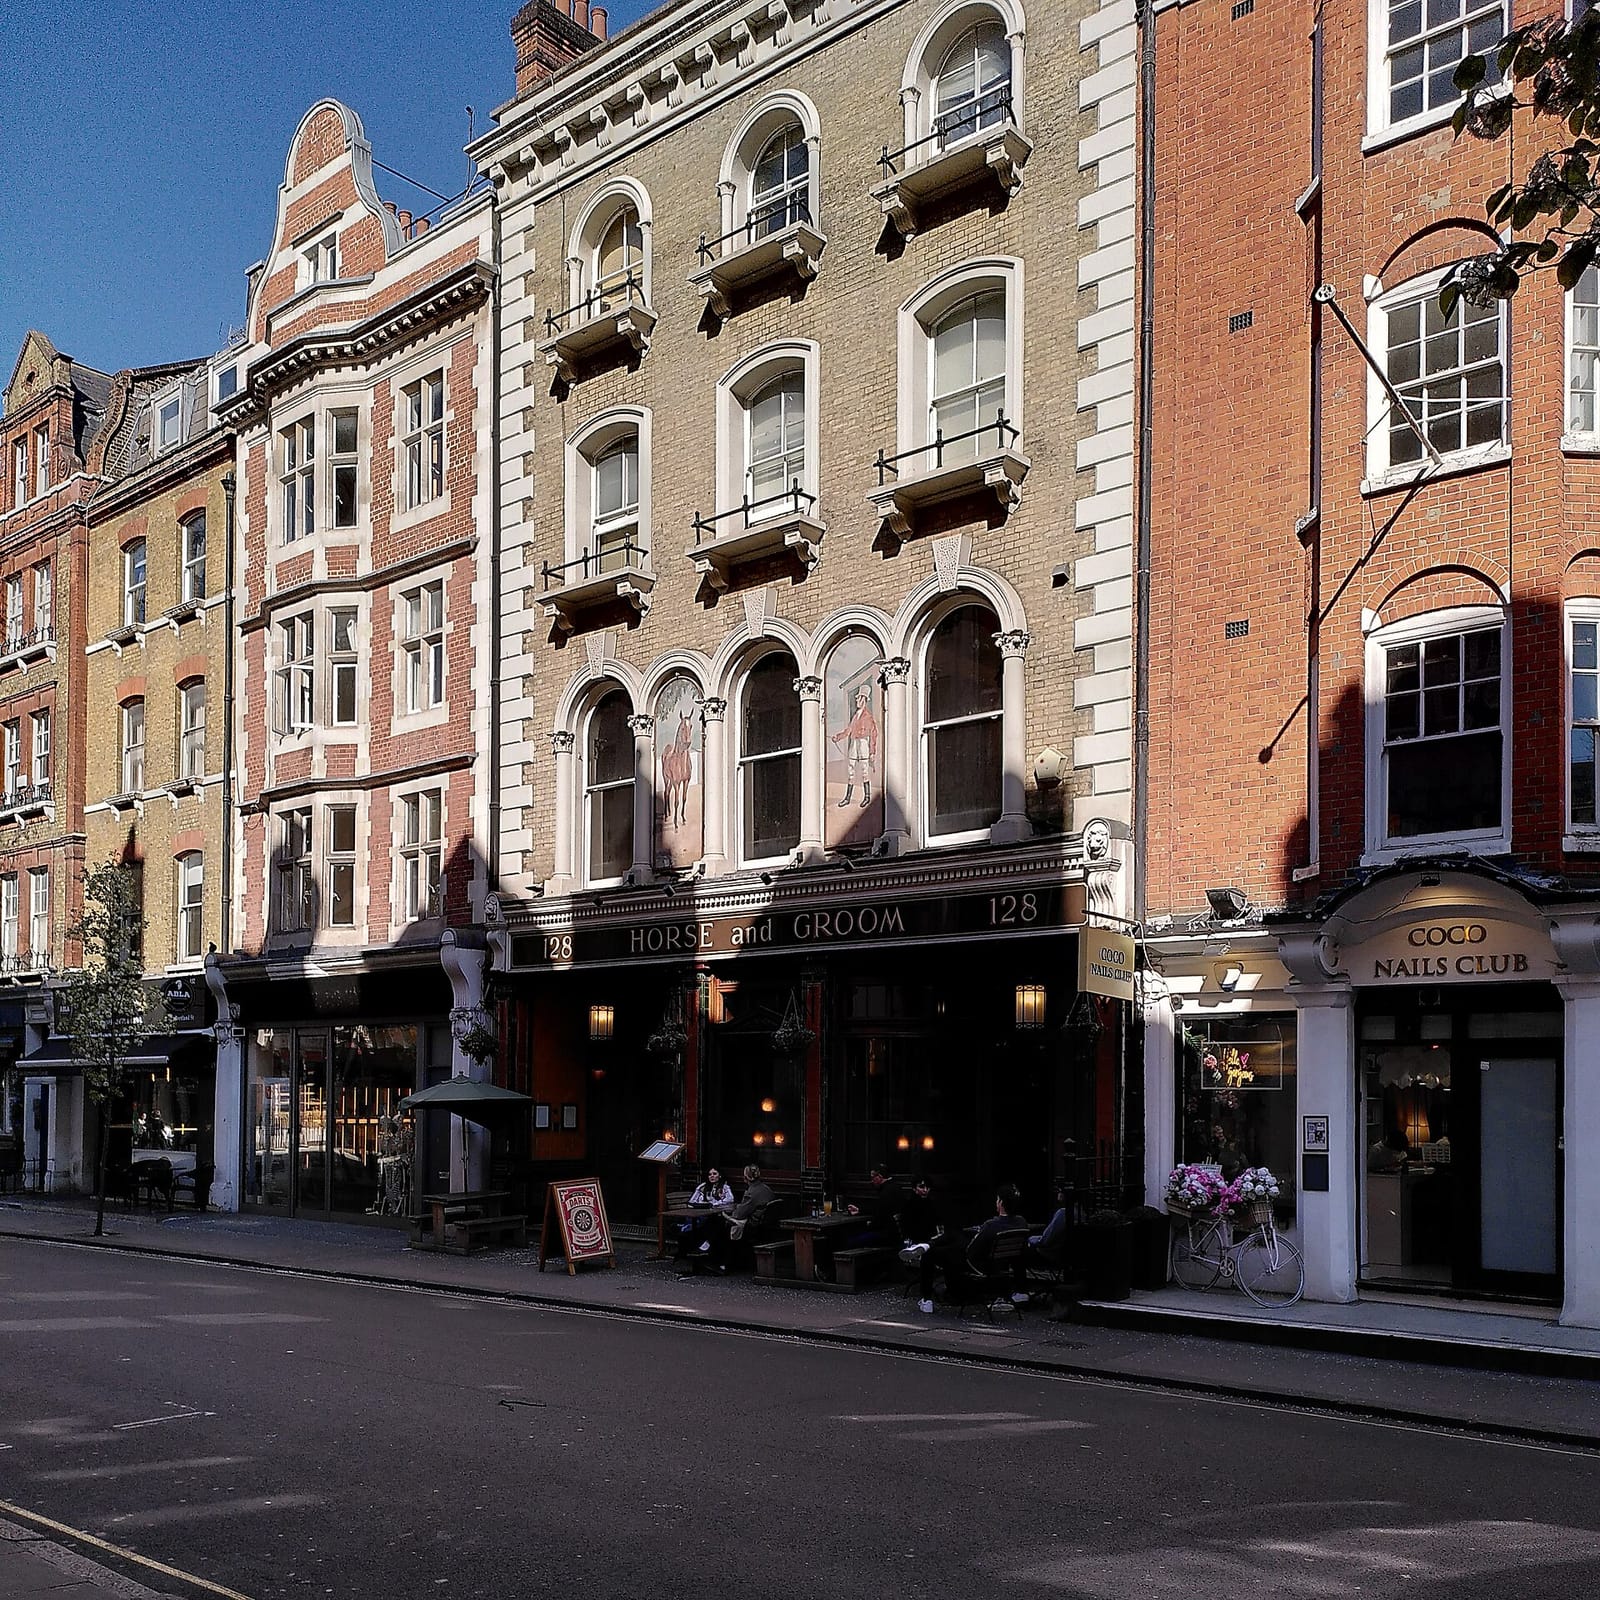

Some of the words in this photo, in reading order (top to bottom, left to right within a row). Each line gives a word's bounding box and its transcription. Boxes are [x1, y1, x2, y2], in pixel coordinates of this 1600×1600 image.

[543, 935, 573, 959] 128
[630, 922, 714, 952] HORSE
[731, 918, 772, 947] and
[793, 905, 906, 940] GROOM
[988, 893, 1038, 925] 128
[1408, 924, 1487, 947] COCO
[1100, 947, 1125, 965] COCO
[1374, 956, 1448, 978] NAILS
[1455, 953, 1529, 975] CLUB
[1090, 963, 1113, 979] NAILS
[569, 1197, 591, 1208] DARTS
